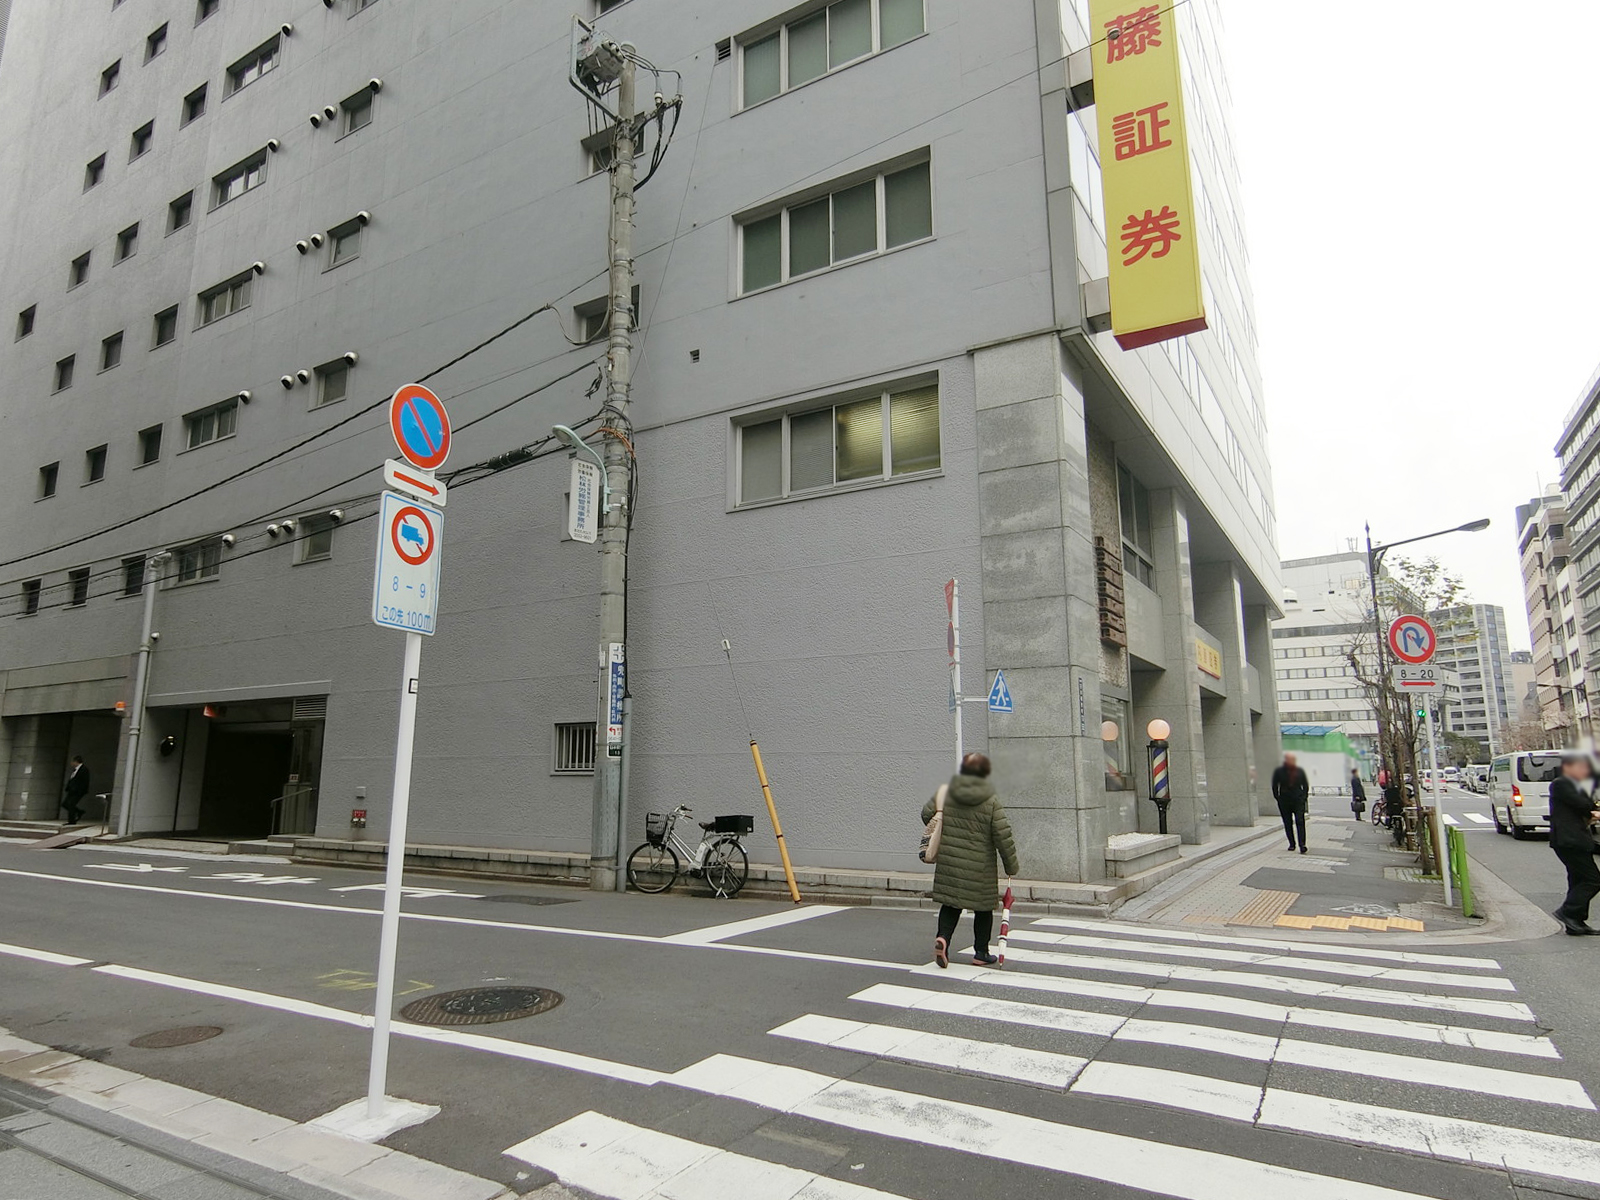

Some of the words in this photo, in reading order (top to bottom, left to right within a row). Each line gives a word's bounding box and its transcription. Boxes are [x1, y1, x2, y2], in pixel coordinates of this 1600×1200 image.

[1103, 4, 1182, 267] 藤証券
[381, 605, 404, 624] この先
